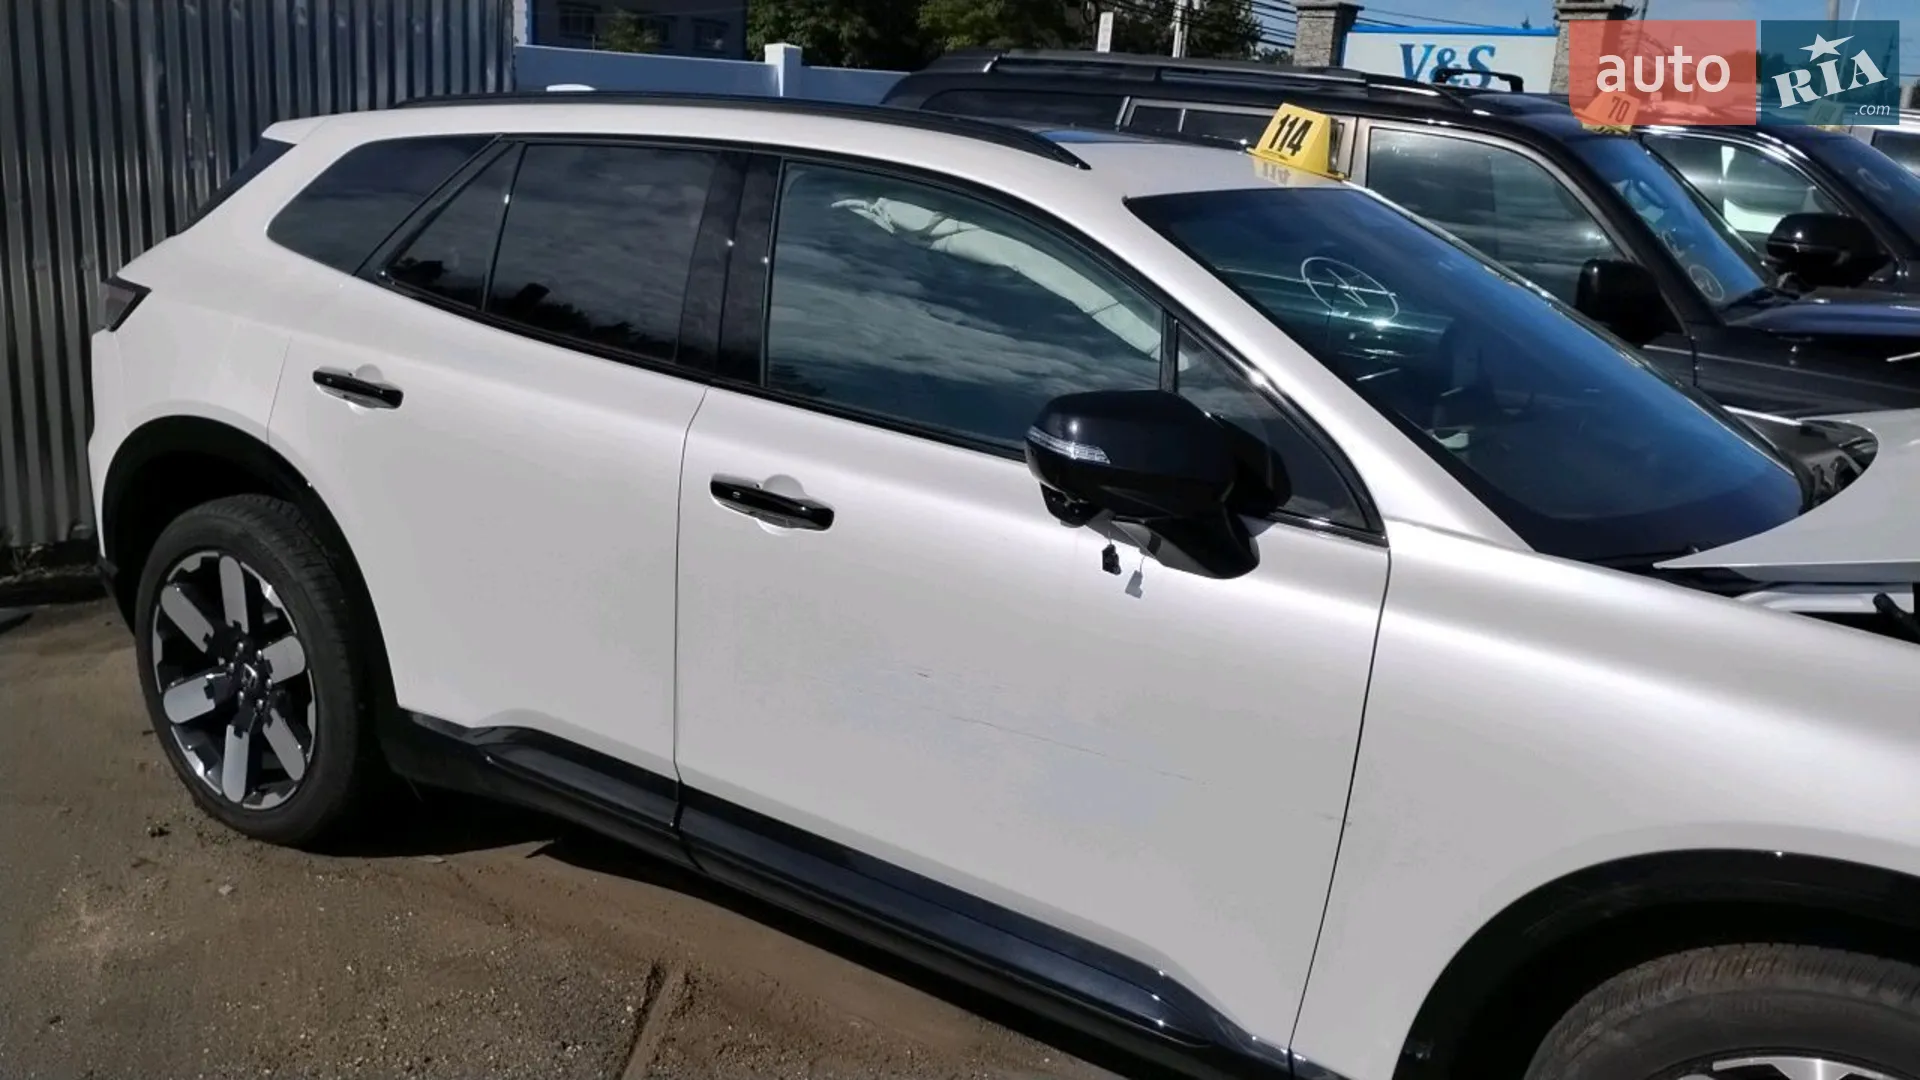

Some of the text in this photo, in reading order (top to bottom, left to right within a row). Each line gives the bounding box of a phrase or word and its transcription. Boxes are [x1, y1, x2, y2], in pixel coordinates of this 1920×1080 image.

[1400, 43, 1496, 88] V&S
[1608, 96, 1630, 123] 70
[1268, 114, 1313, 156] 114
